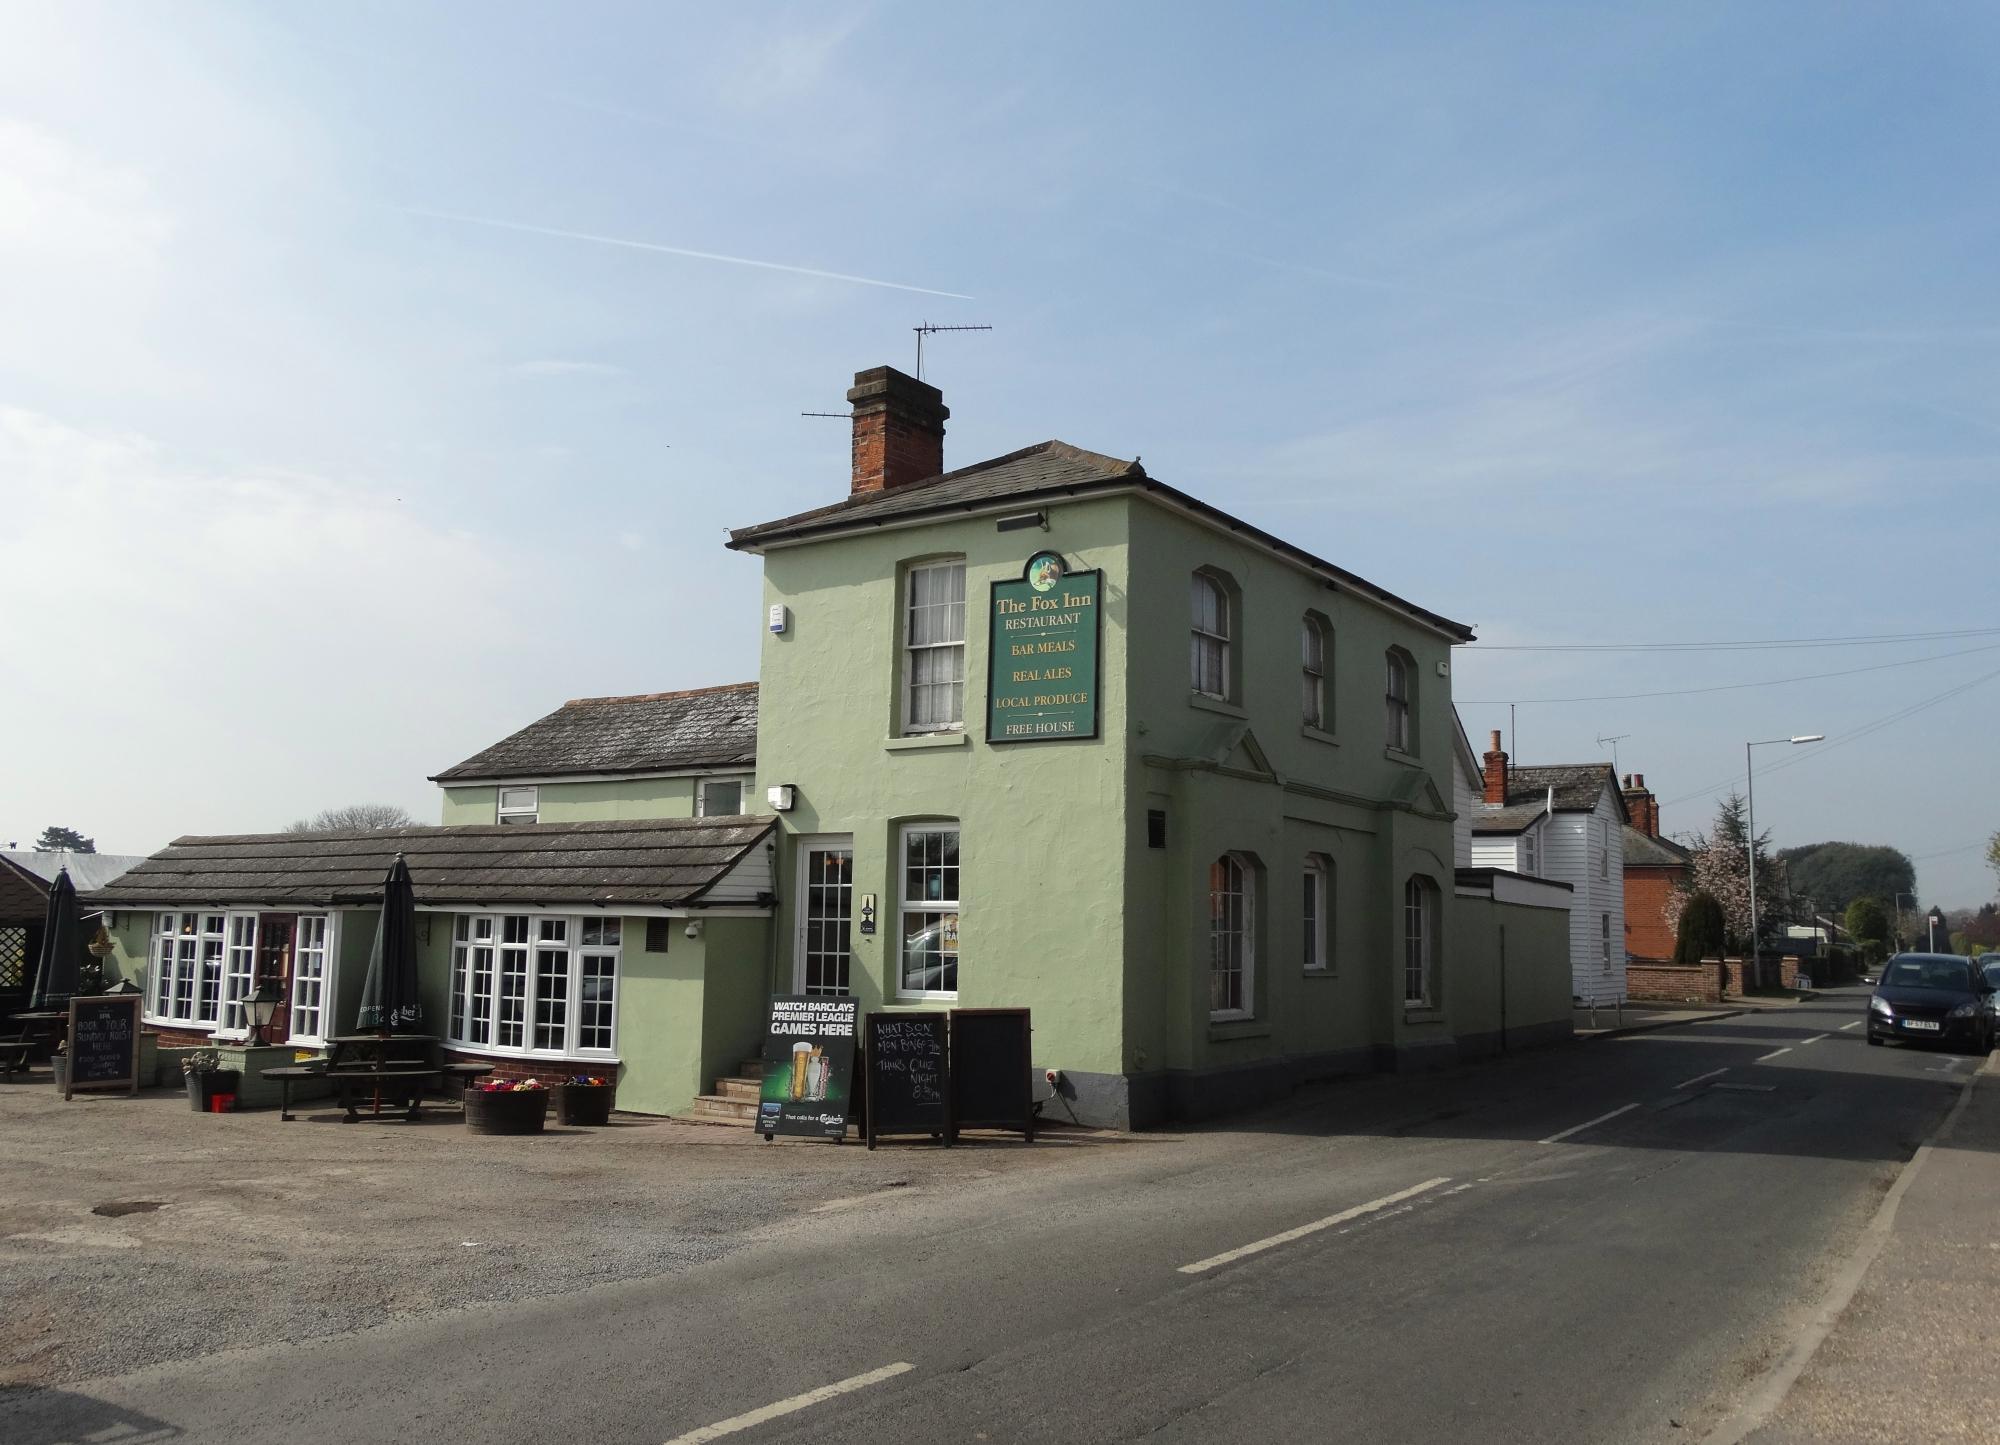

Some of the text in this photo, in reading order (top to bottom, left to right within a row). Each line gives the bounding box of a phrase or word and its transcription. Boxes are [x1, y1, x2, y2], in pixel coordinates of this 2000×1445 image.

[997, 592, 1092, 615] The Fox Inn
[1005, 612, 1081, 630] RESTAURANT
[1011, 639, 1075, 656] BAR MEALS
[1012, 666, 1072, 682] REAL ALES
[996, 692, 1088, 709] LOCAL PRODUCE
[1006, 721, 1075, 735] FREE HOUSE
[774, 1001, 855, 1012] WATCH BARCLAYS
[771, 1011, 854, 1023] PREMIER LEAGUE
[770, 1022, 853, 1036] GAMES HERE
[914, 1023, 931, 1032] ON
[878, 1040, 897, 1052] MON
[909, 1058, 936, 1073] QUIZ
[910, 1073, 938, 1086] NIGHT
